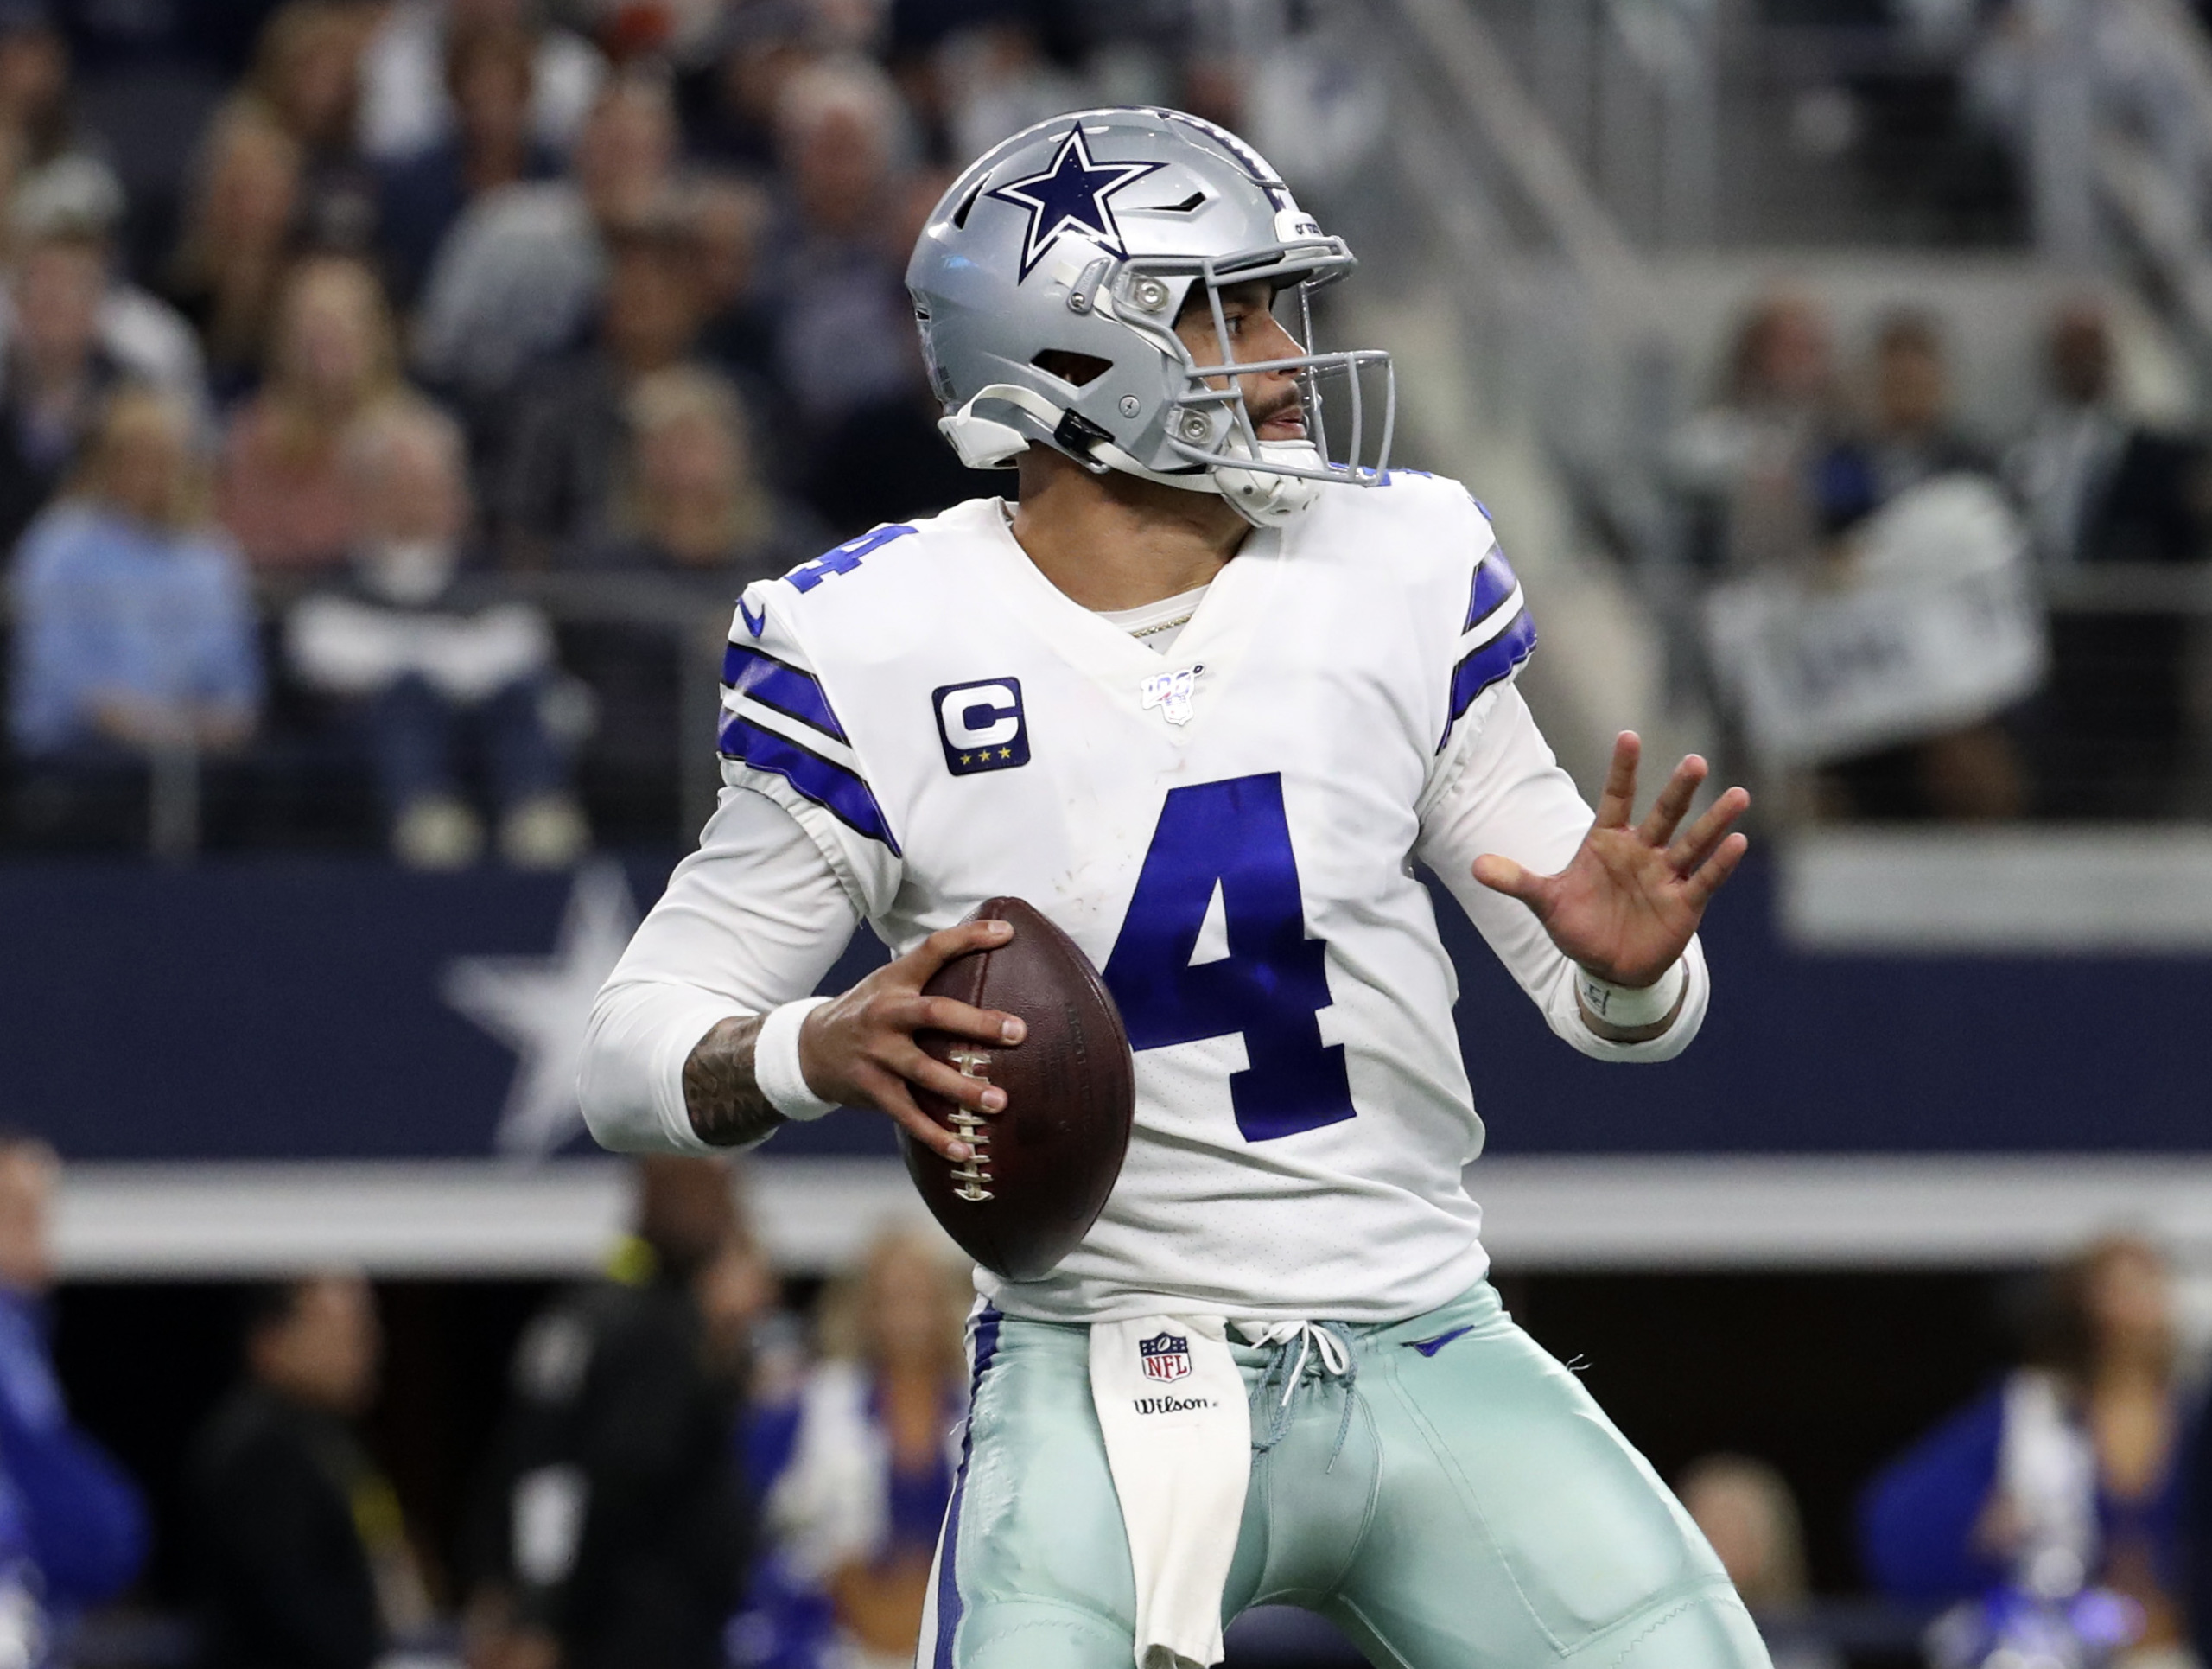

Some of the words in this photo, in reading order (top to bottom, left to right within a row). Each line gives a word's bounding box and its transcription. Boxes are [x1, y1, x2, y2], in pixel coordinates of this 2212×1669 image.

[941, 684, 1020, 750] C
[1102, 771, 1357, 1143] 4
[1146, 1354, 1188, 1379] NFL
[1133, 1395, 1209, 1415] Wilson
